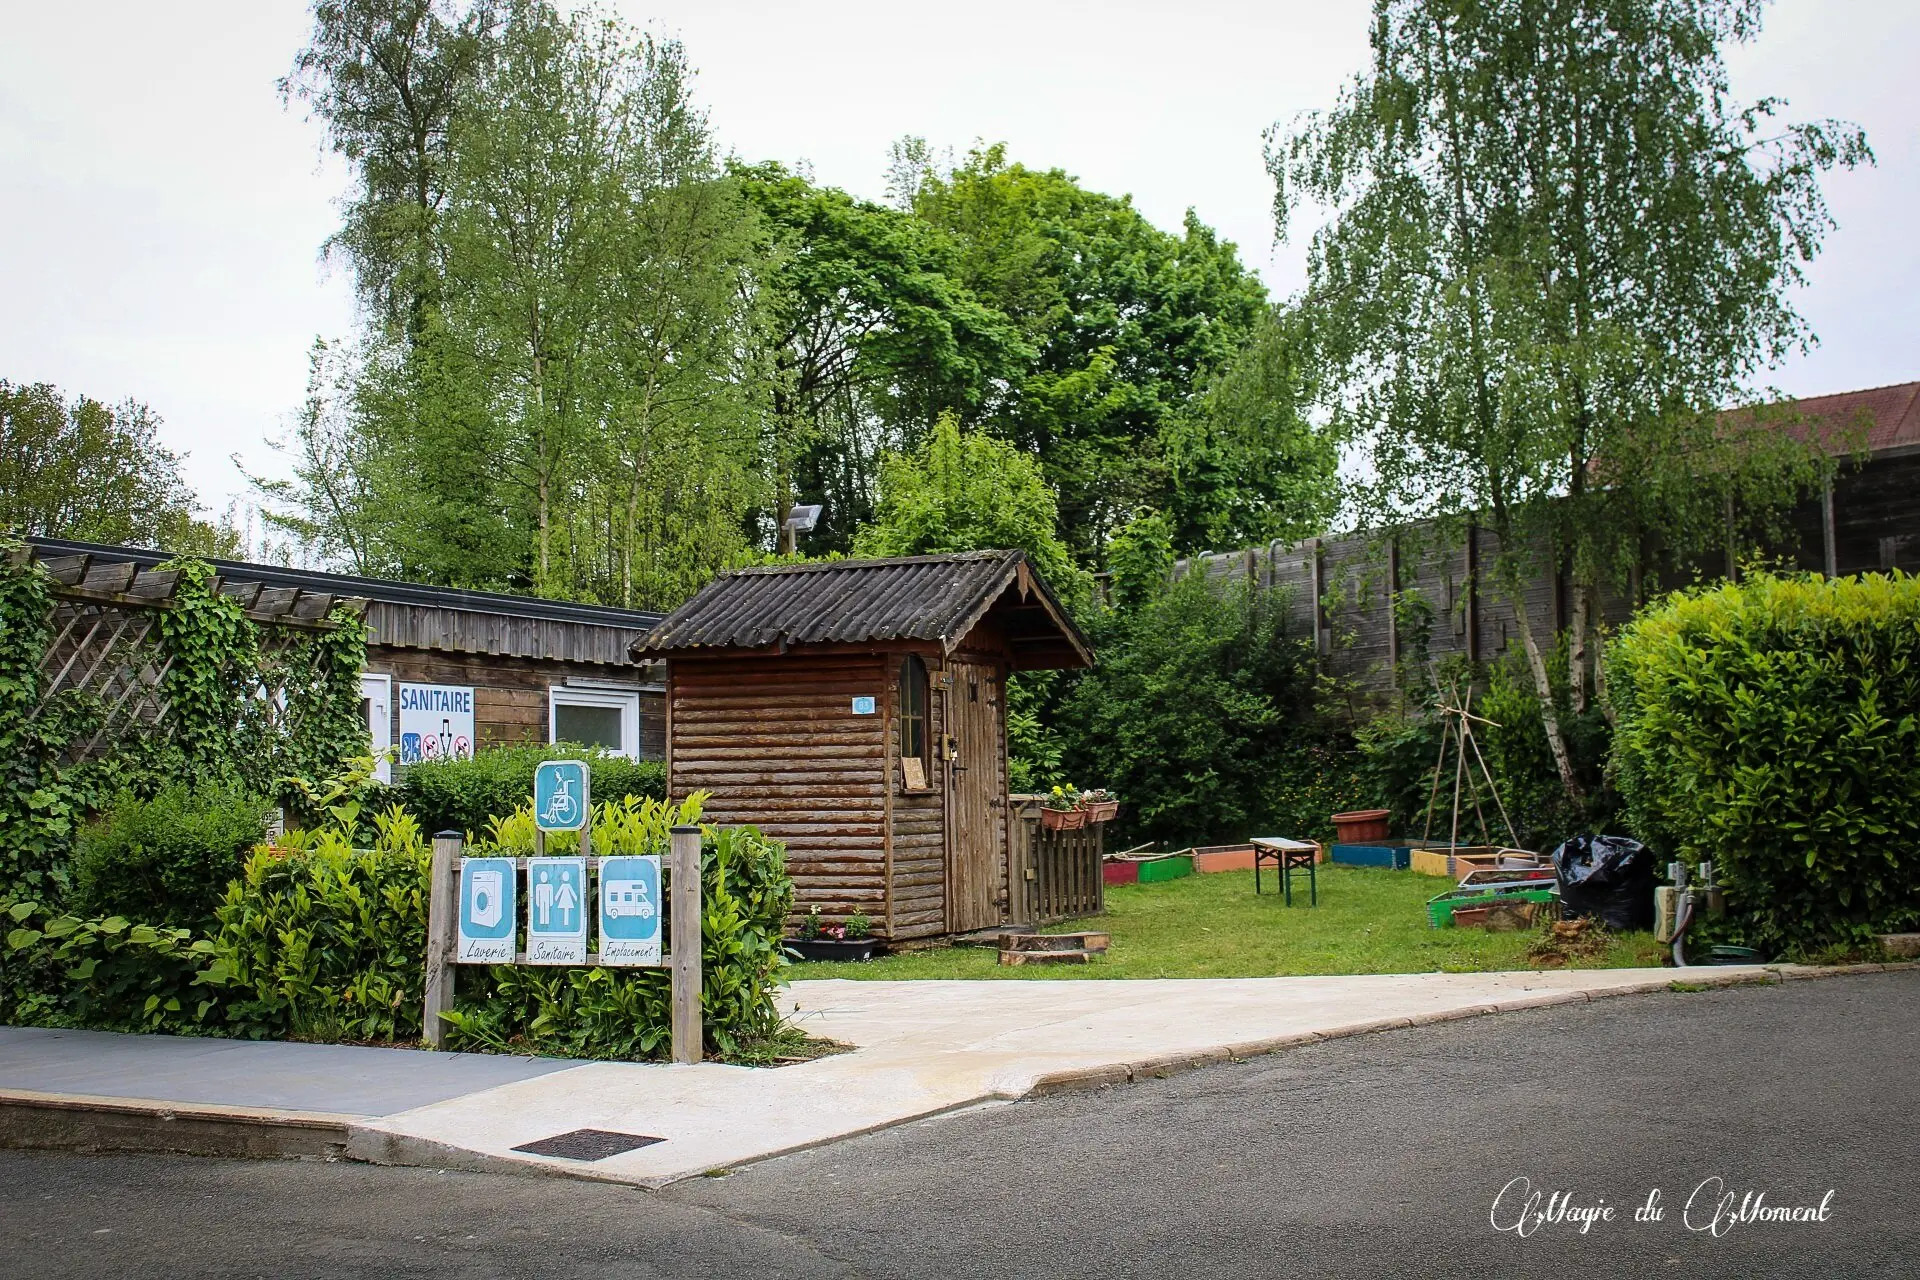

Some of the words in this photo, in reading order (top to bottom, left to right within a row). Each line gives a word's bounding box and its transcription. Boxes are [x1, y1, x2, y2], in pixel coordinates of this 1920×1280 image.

[401, 688, 471, 713] SANITAIRE
[466, 939, 508, 958] Laverie
[533, 941, 576, 960] Sanitaire
[604, 941, 654, 963] Emplacement
